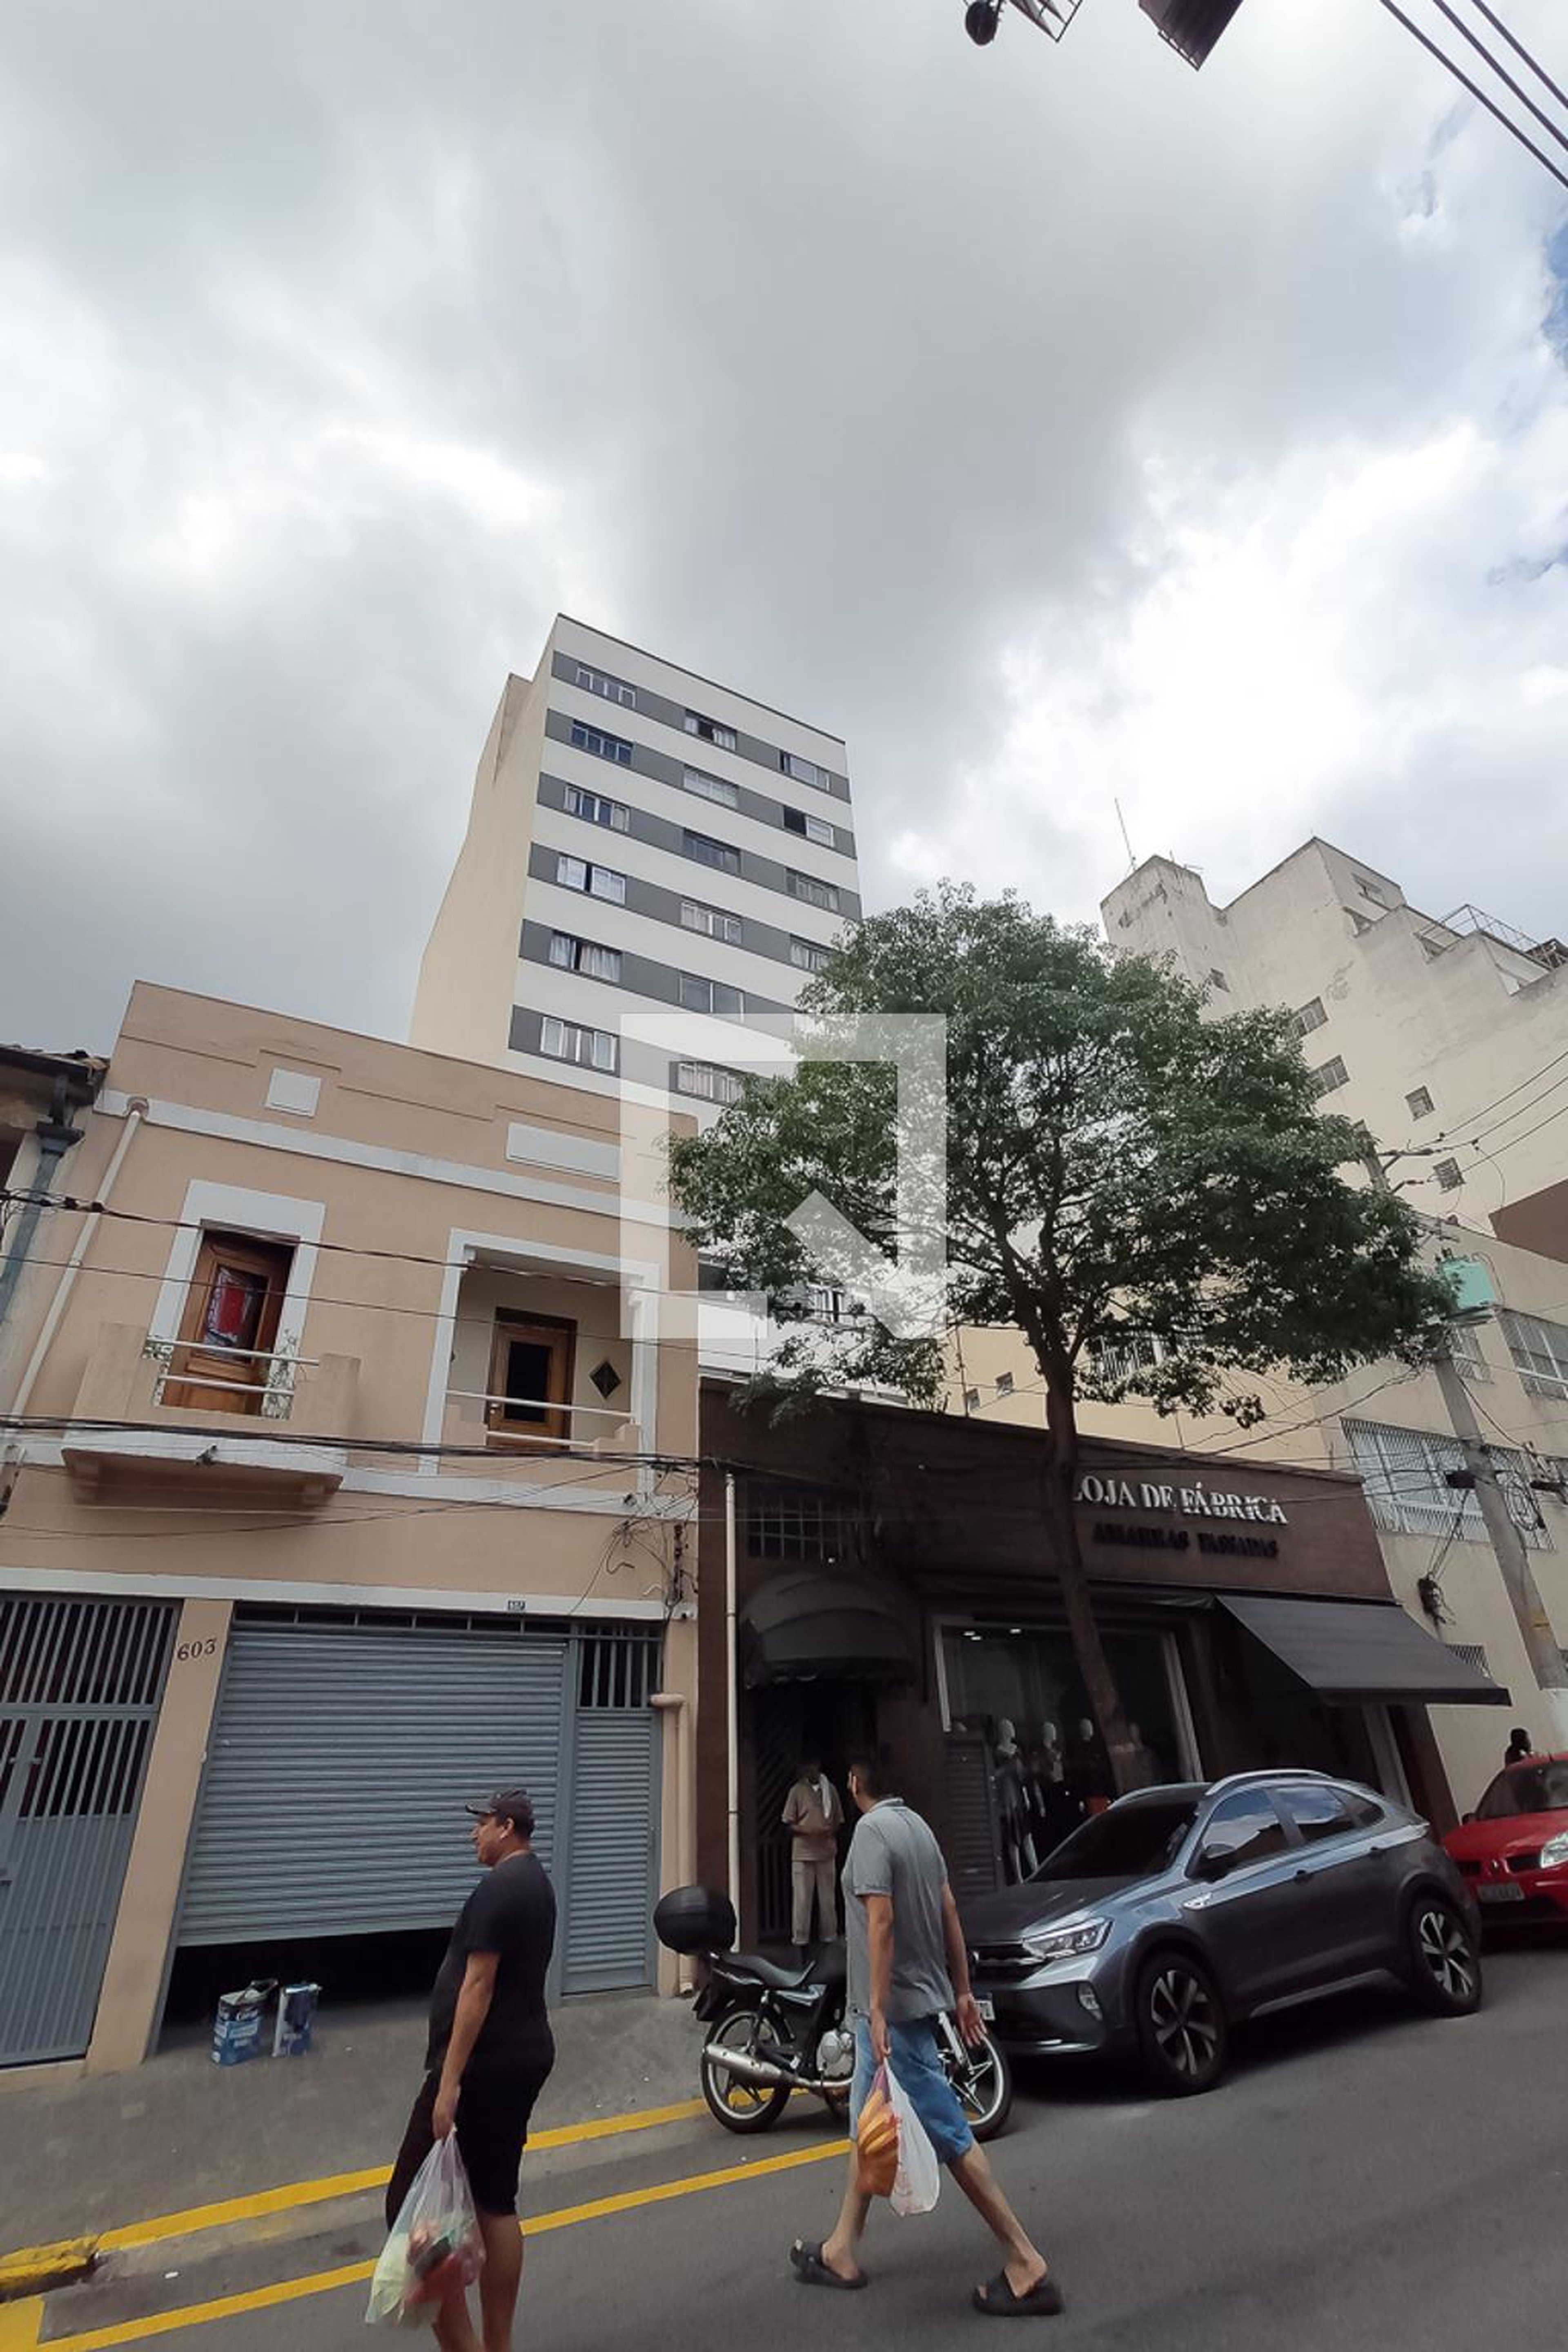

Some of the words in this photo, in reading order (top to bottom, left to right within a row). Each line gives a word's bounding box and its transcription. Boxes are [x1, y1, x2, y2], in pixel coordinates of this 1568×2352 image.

[1140, 1483, 1177, 1510] DE
[1179, 1481, 1288, 1524] FÁBRICA
[177, 1638, 217, 1661] 603
